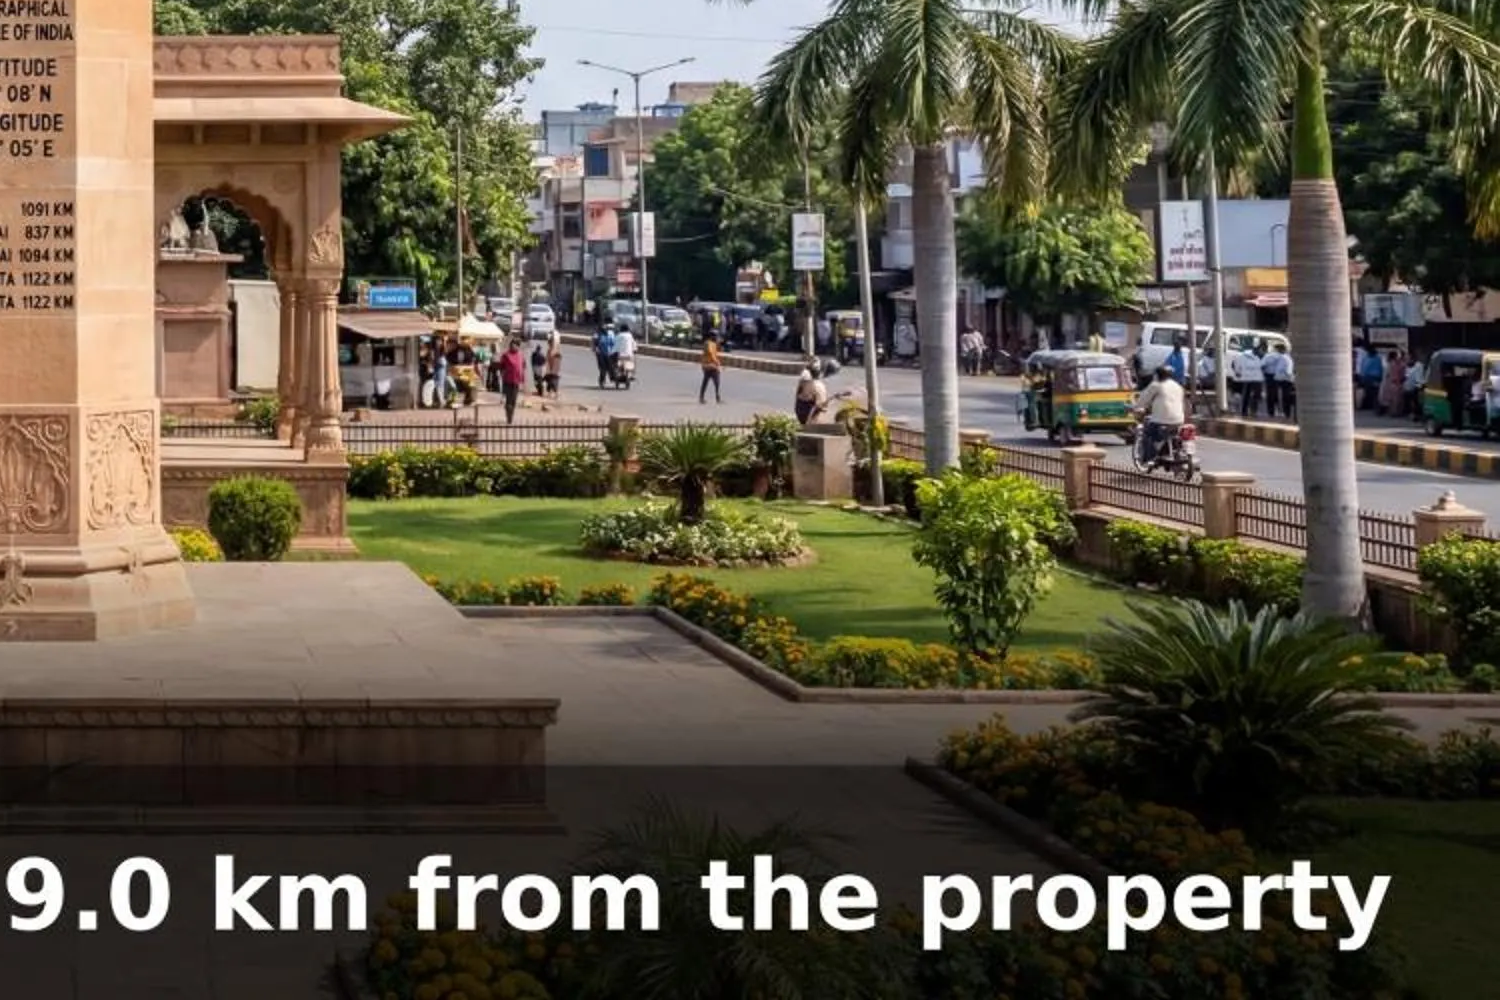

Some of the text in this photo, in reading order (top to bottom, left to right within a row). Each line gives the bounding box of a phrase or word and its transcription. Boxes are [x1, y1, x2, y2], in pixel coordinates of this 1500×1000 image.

[13, 24, 30, 41] OF
[35, 24, 73, 41] INDIA
[40, 85, 51, 103] N
[43, 139, 55, 157] E
[21, 202, 49, 217] 1091
[53, 202, 73, 217] KM
[25, 226, 50, 240] 837
[53, 226, 74, 240] KM
[19, 248, 50, 263] 1094
[53, 248, 74, 263] KM
[23, 272, 51, 287] 1122
[53, 272, 74, 287] KM
[23, 295, 51, 310] 1122
[53, 295, 74, 310] KM
